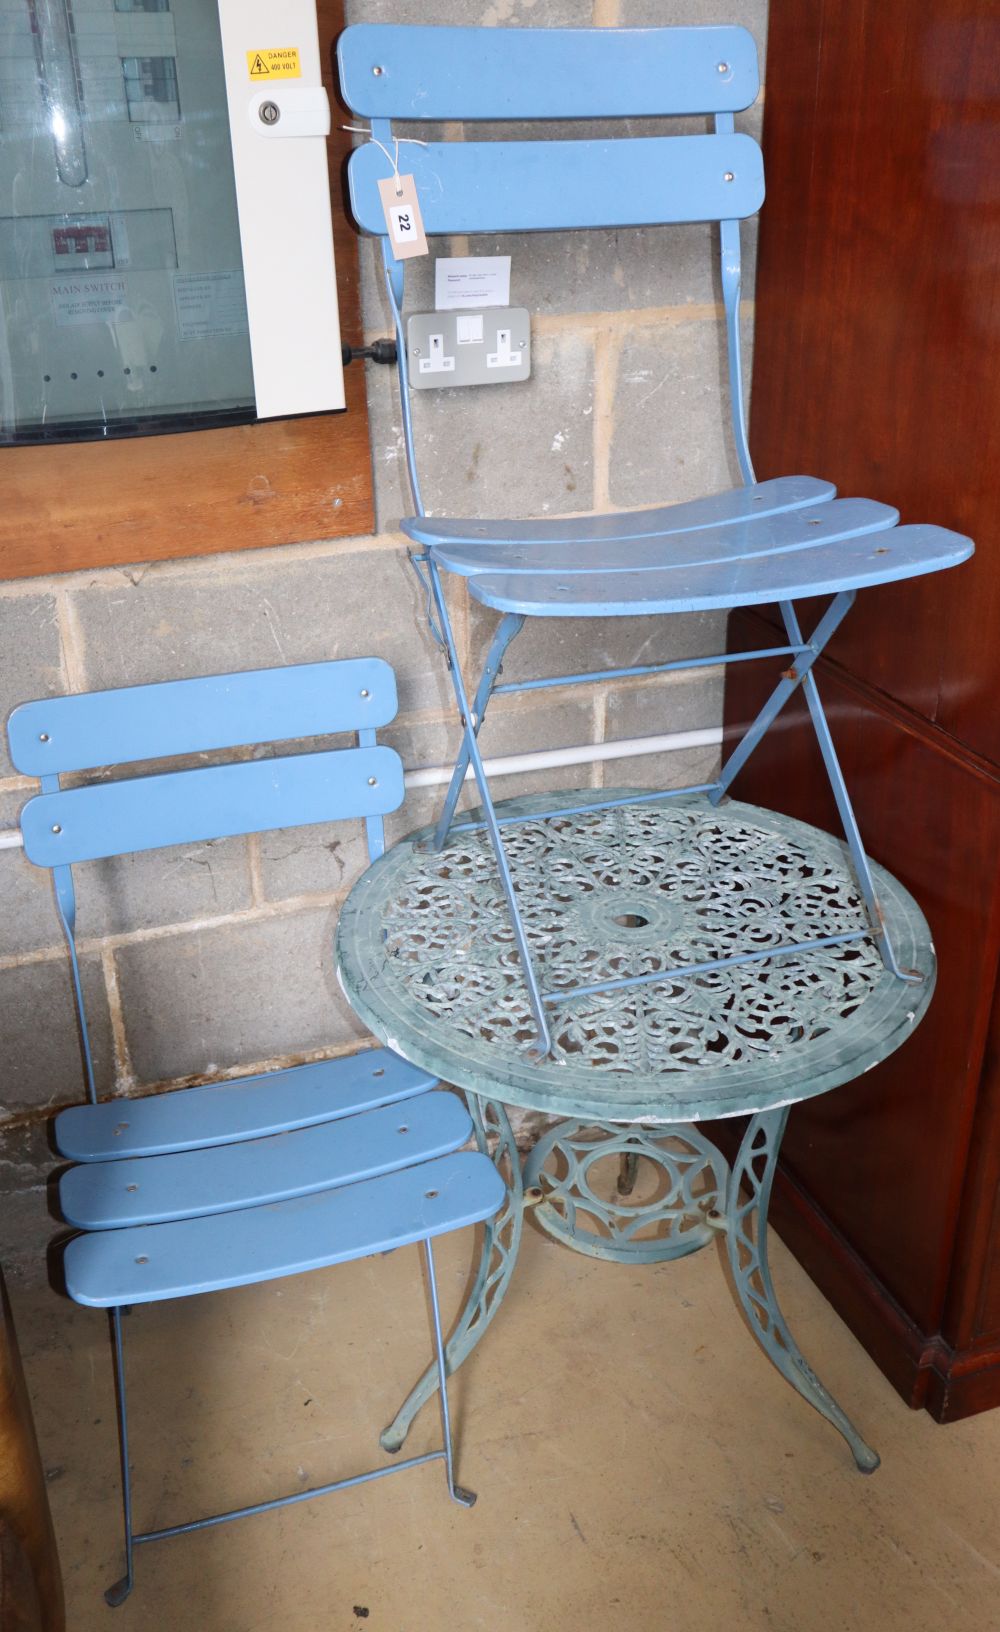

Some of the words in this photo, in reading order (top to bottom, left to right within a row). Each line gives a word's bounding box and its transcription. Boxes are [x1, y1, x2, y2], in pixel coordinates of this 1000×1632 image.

[268, 51, 297, 59] DANGER
[282, 62, 296, 70] VOLT
[398, 213, 411, 232] 22
[52, 285, 81, 296] MAIN
[84, 281, 125, 293] SWITCH
